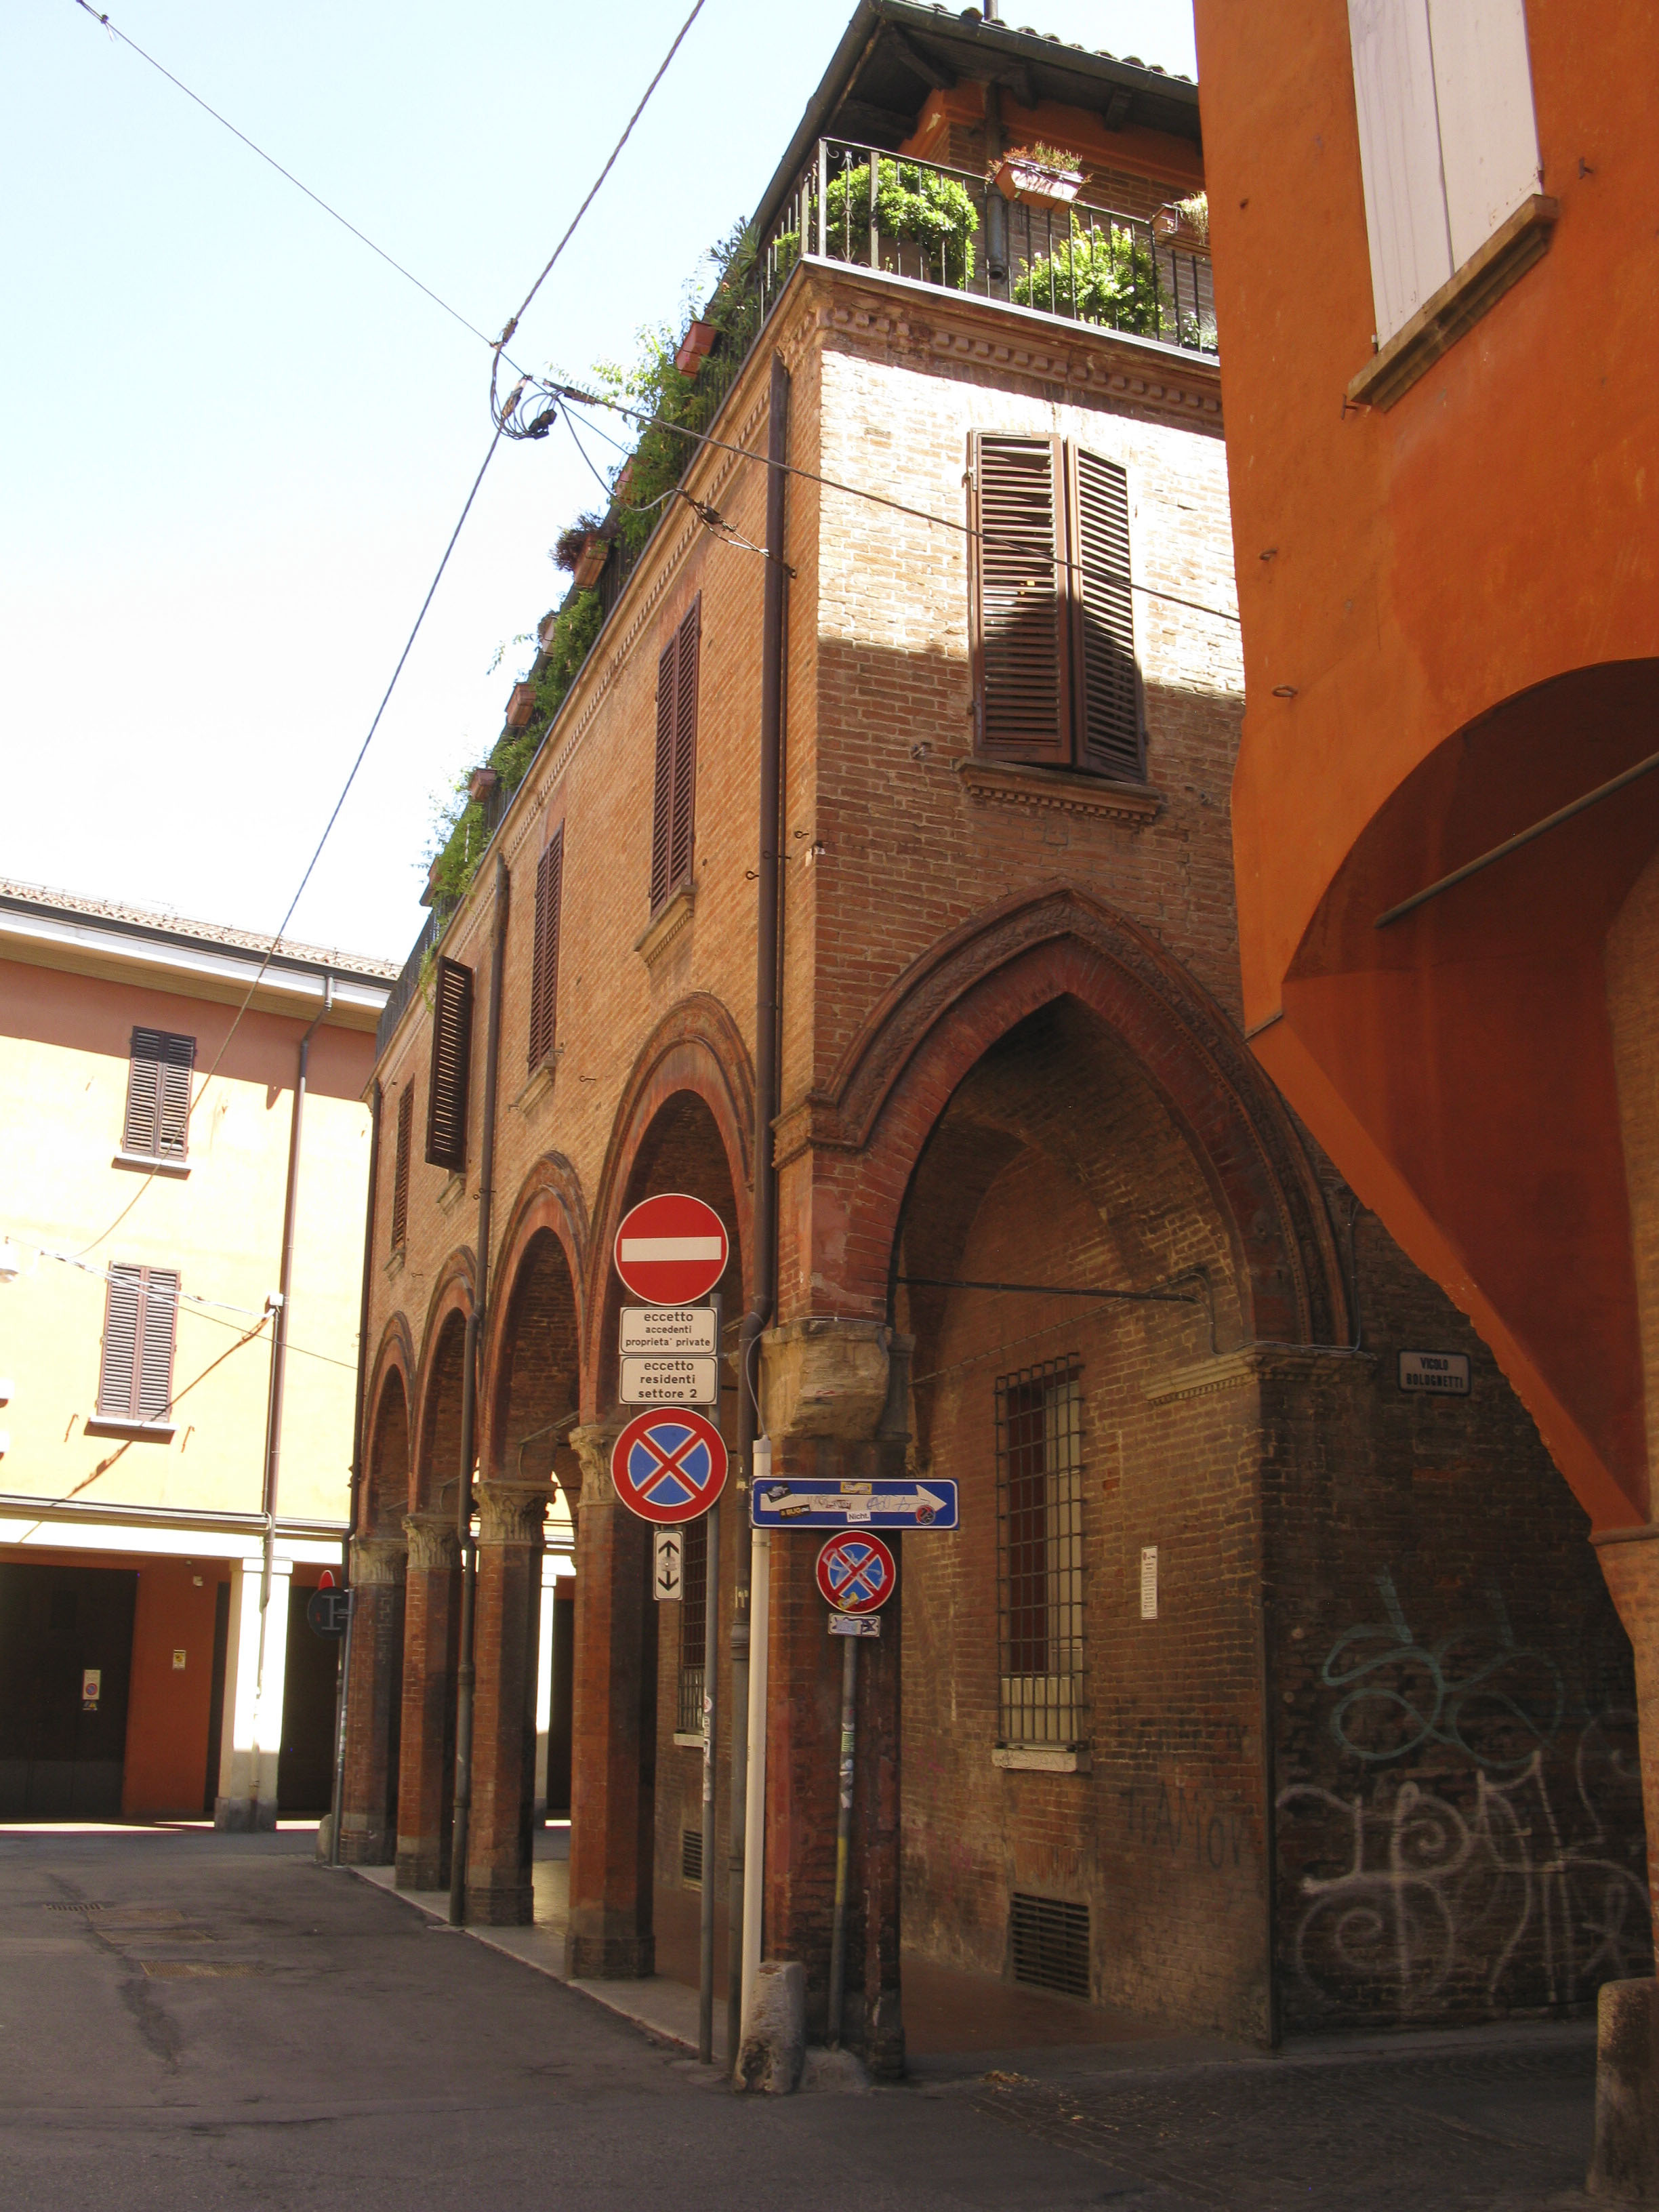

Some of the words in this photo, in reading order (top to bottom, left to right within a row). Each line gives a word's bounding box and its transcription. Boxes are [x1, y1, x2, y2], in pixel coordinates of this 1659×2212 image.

[644, 1312, 693, 1322] eccetto
[645, 1326, 692, 1334] accedenti
[676, 1338, 710, 1347] private
[644, 1361, 694, 1370] eccetto
[640, 1374, 695, 1384] residenti
[638, 1389, 684, 1398] settore
[689, 1389, 697, 1398] 2
